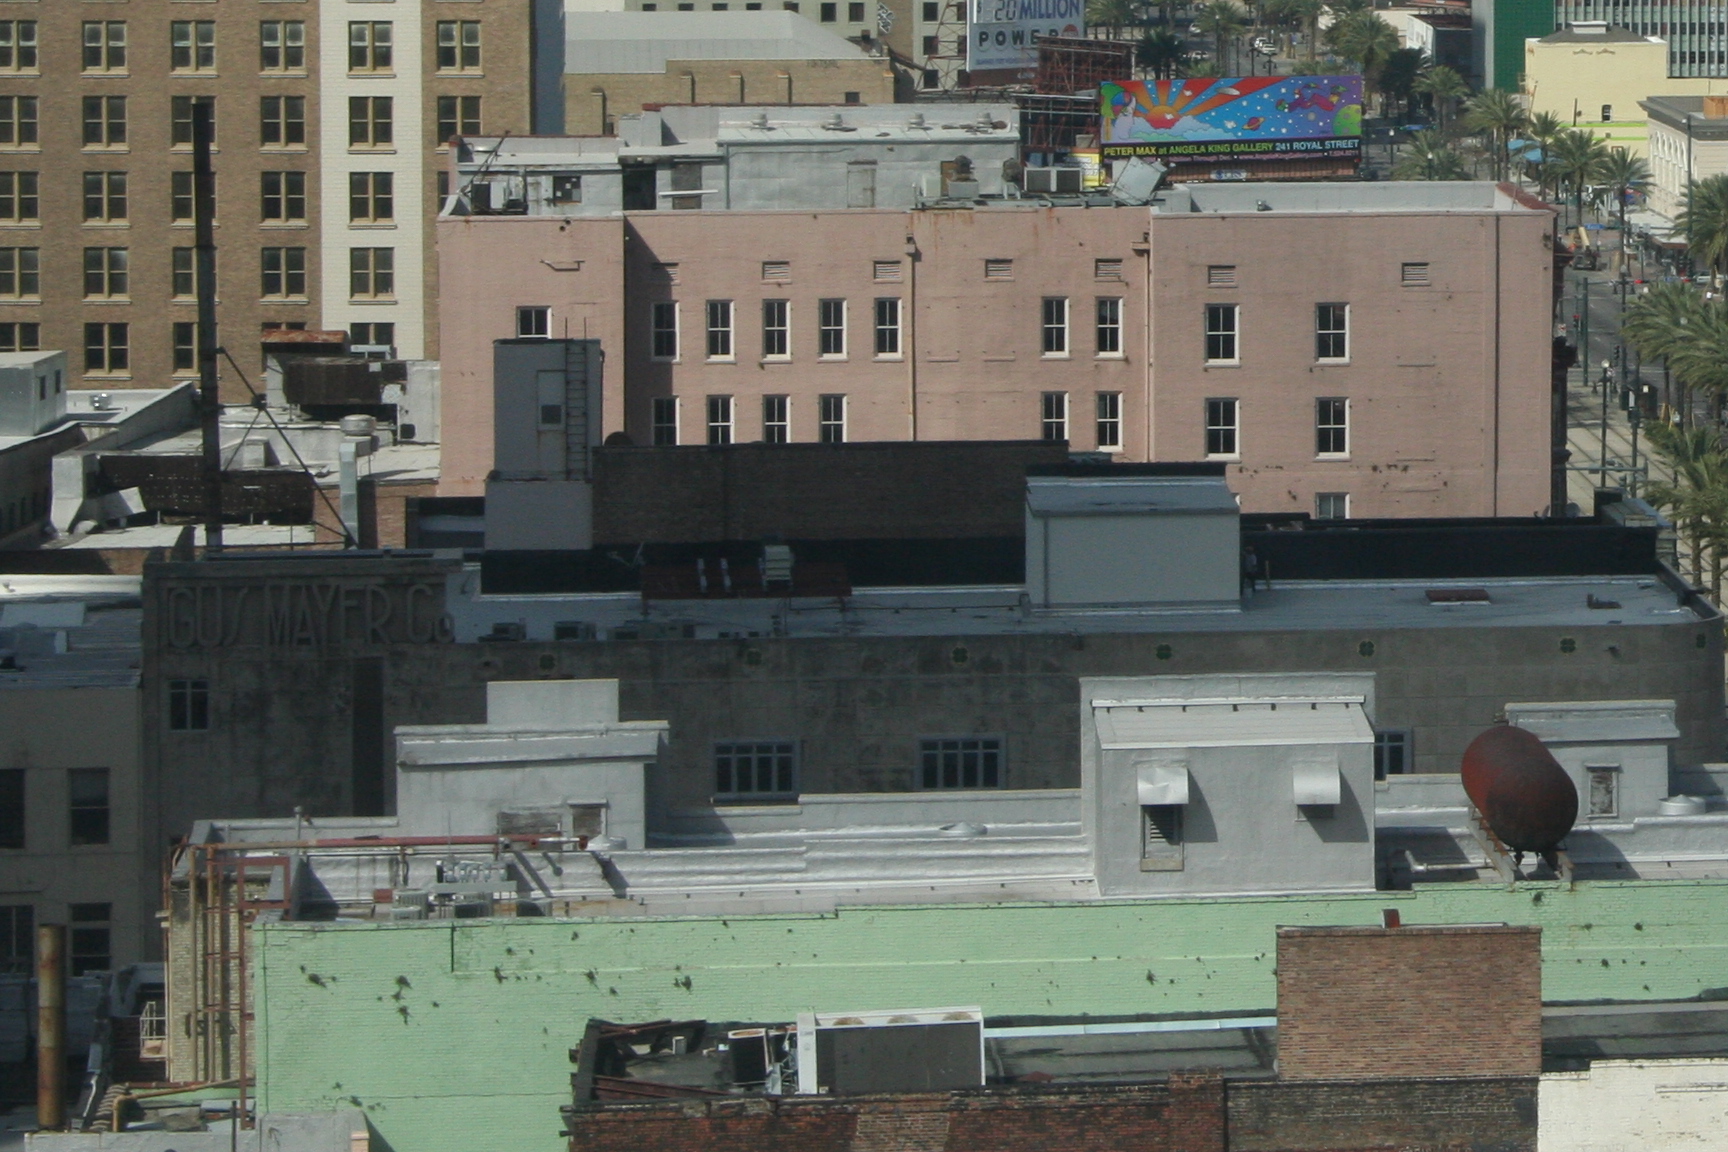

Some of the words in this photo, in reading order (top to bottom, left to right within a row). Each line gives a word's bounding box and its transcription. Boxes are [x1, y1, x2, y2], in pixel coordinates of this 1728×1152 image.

[1104, 148, 1134, 156] PETER
[1136, 147, 1156, 155] MAX
[1169, 145, 1206, 154] ANGELA
[1208, 144, 1230, 153] KING
[1232, 142, 1273, 152] GALLERY
[1275, 142, 1290, 151] 241
[1293, 141, 1322, 150] ROYAL
[1325, 139, 1359, 149] STREET
[168, 584, 250, 649] GUS
[265, 582, 393, 648] MAYER
